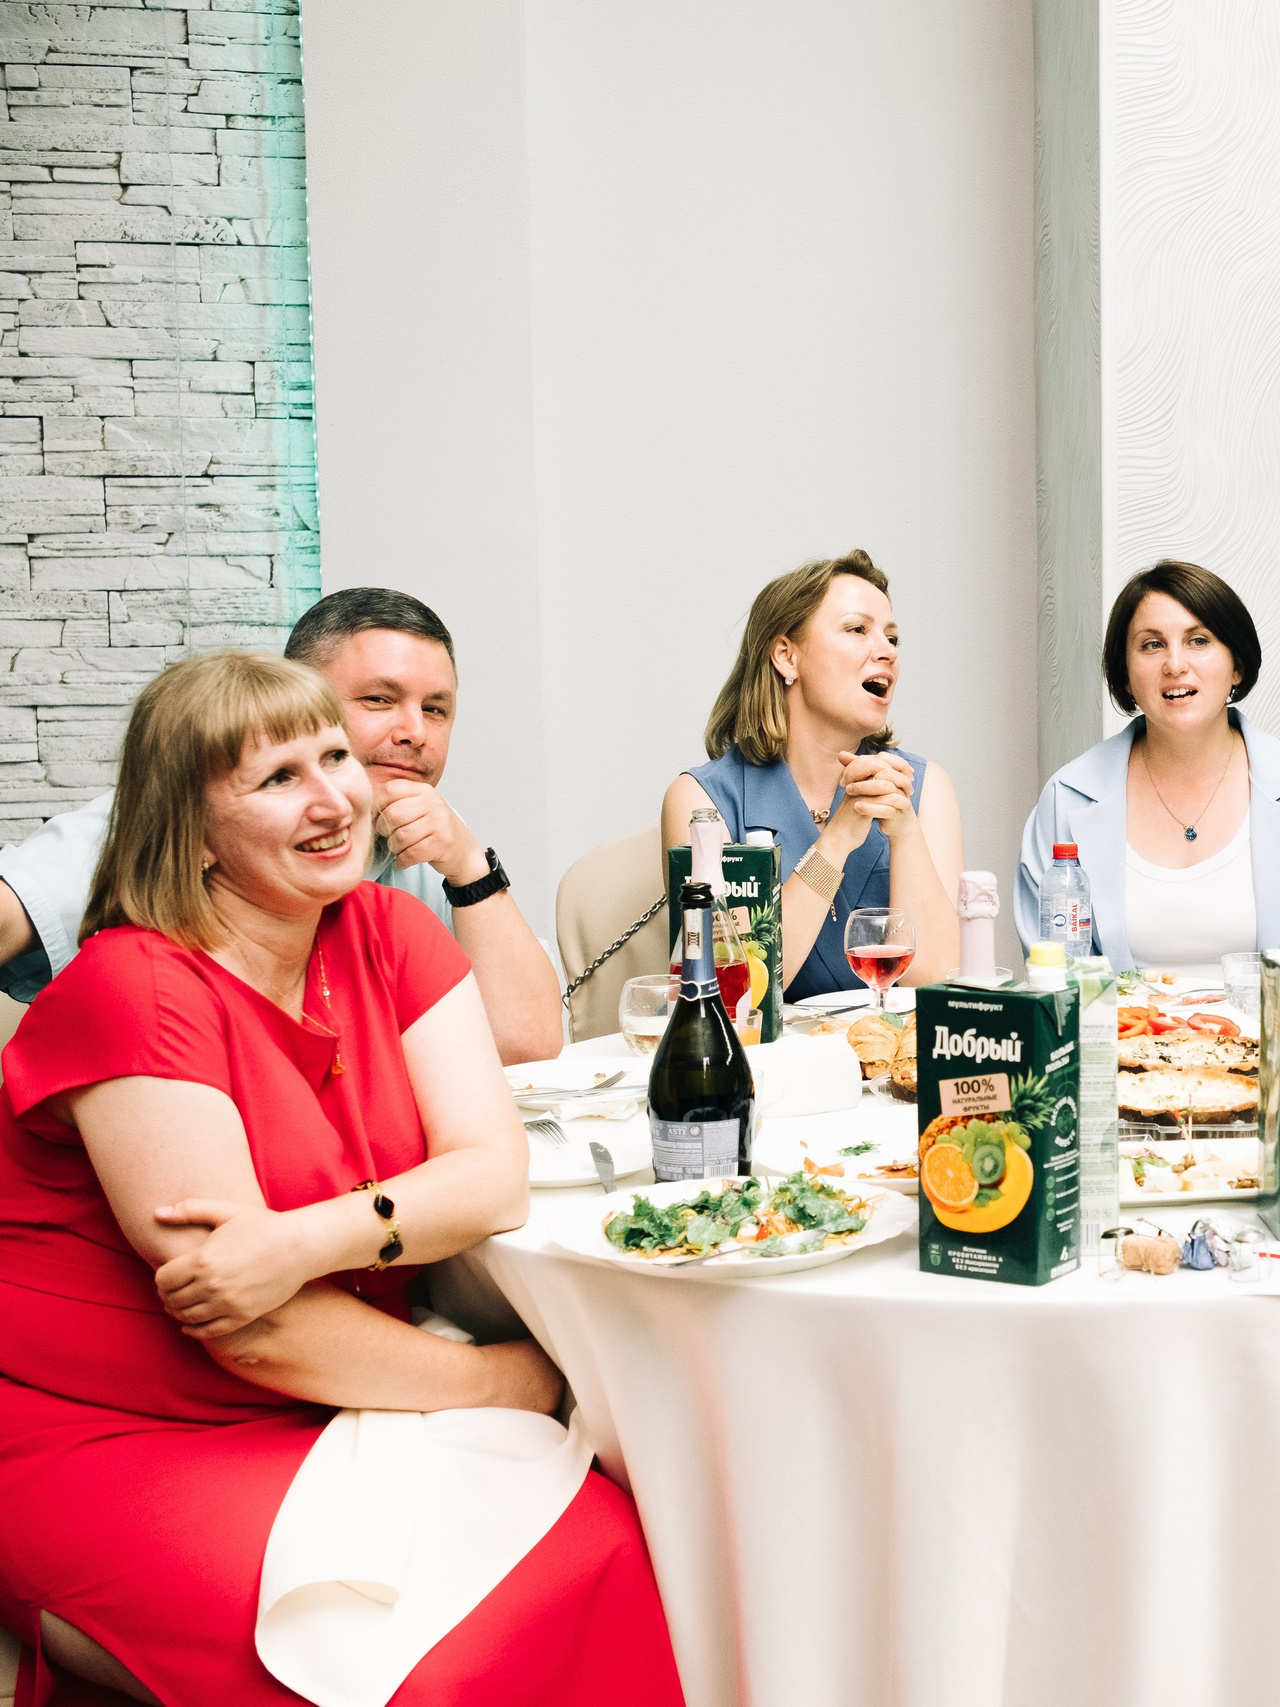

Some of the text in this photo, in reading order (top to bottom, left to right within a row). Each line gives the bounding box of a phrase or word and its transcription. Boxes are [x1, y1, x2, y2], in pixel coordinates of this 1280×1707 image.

[948, 1000, 1004, 1012] мультифрукт
[932, 1025, 1021, 1064] Добрый
[954, 1078, 995, 1096] 100%
[952, 1094, 998, 1105] НАТУРАЛЬНЫЕ
[963, 1105, 990, 1113] ФРУКТЫ
